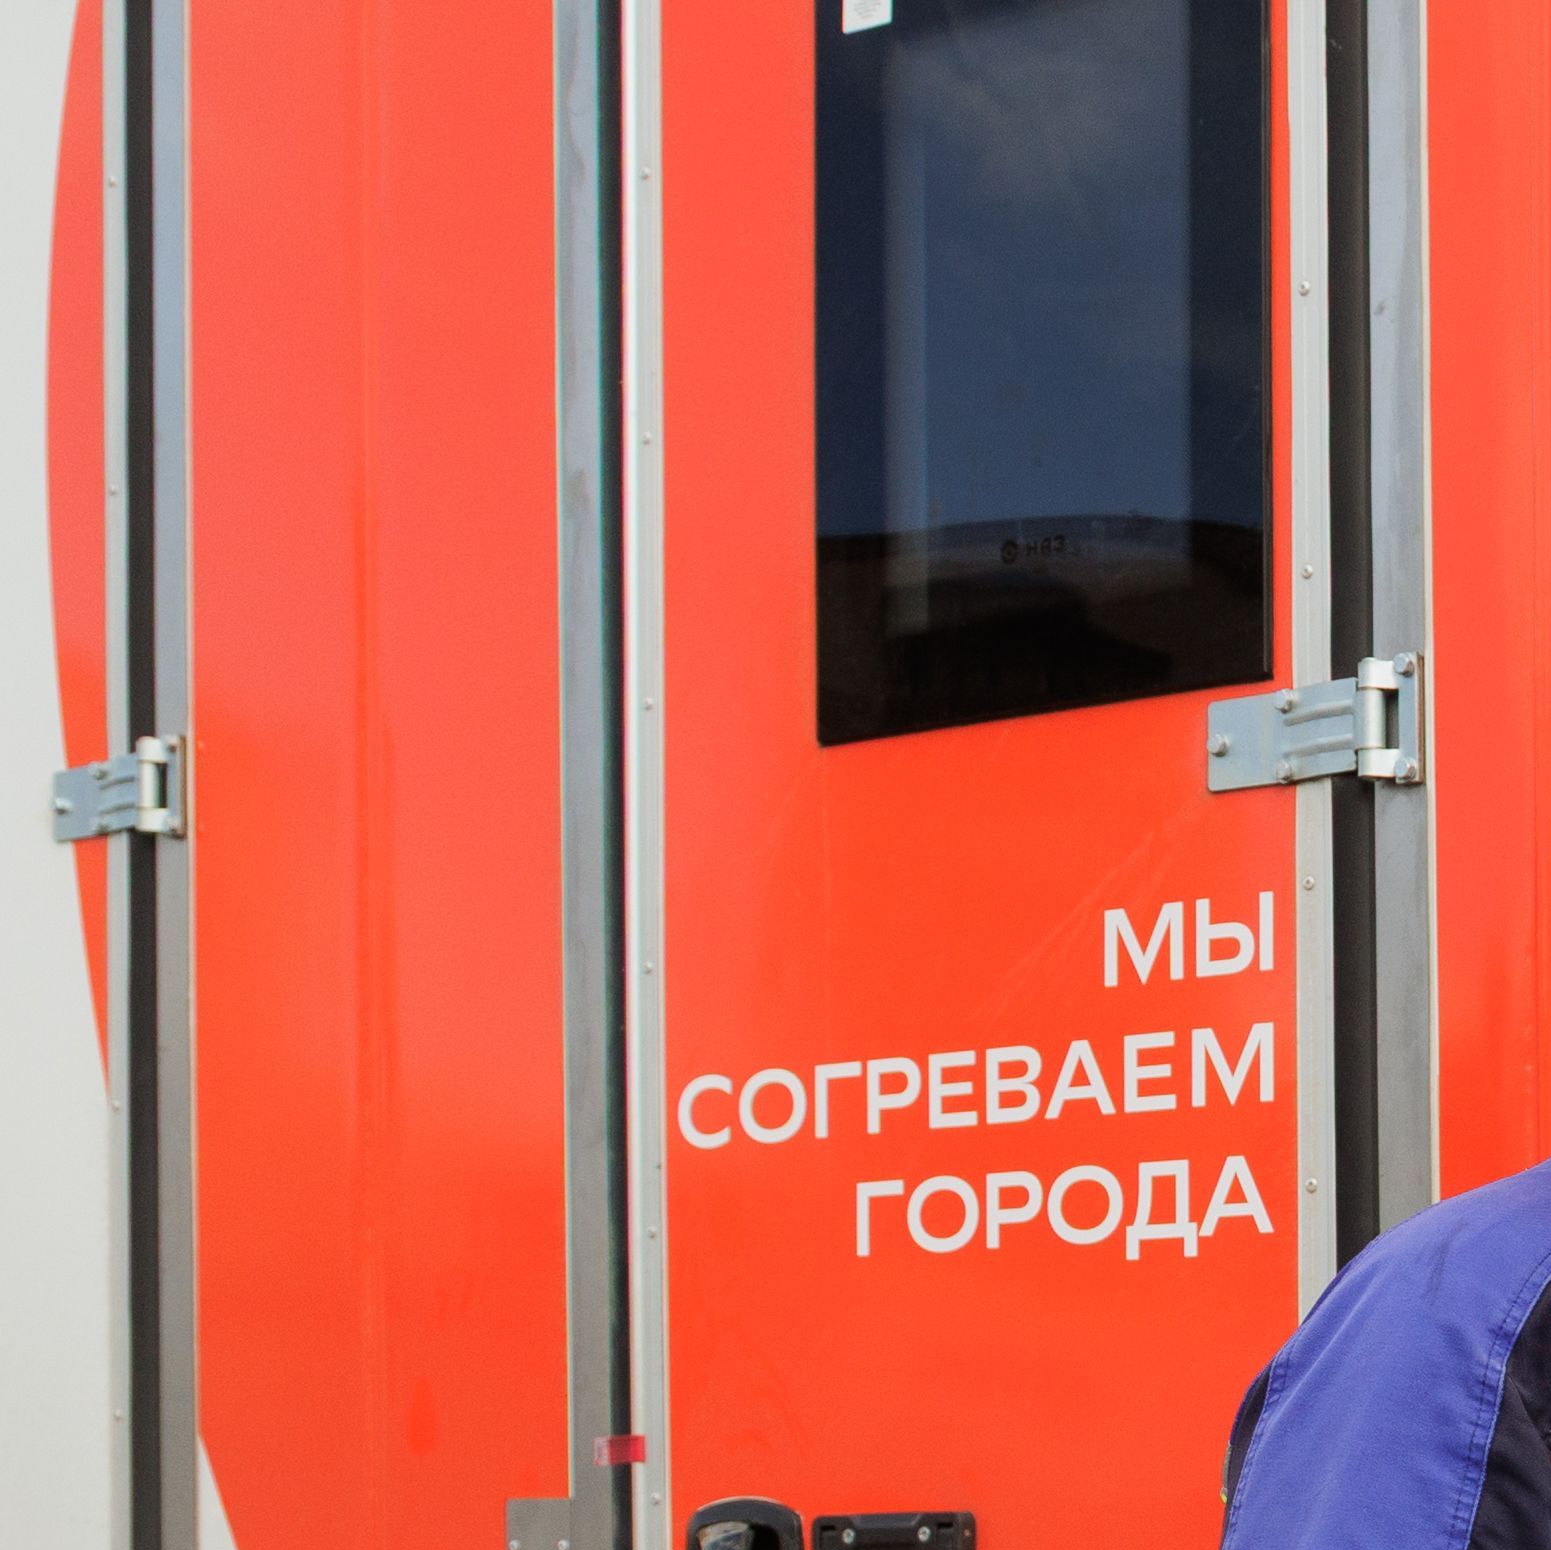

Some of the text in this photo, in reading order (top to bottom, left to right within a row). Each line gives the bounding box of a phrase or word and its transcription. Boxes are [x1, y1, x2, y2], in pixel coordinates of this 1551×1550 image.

[1103, 890, 1275, 987] МЫ
[677, 1021, 1275, 1150] СОГРЕВАЕМ
[856, 1155, 1274, 1261] ГОРОДА
